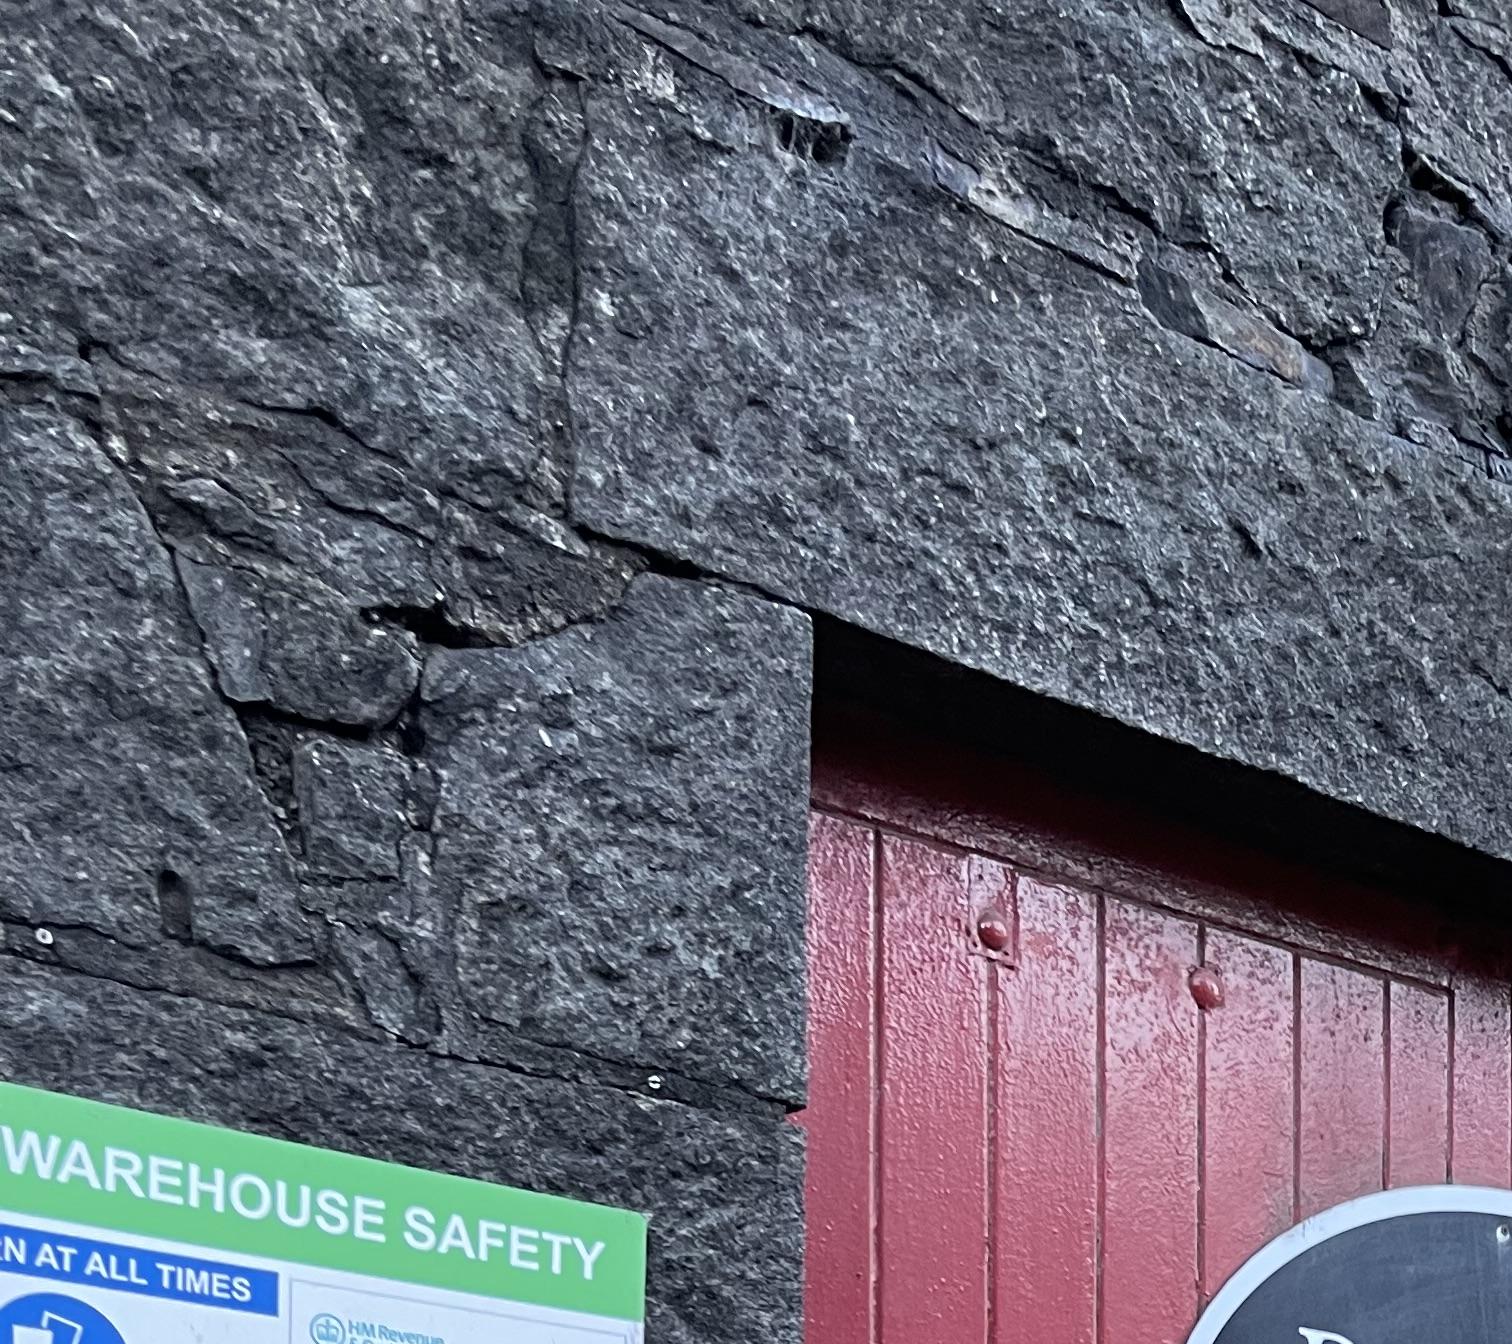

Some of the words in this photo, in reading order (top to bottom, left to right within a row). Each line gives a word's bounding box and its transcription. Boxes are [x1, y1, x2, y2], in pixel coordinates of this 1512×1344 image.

[0, 1124, 386, 1244] WAREHOUSE
[403, 1206, 605, 1280] SAFETY
[0, 1234, 26, 1264] N
[34, 1242, 78, 1272] AT
[84, 1251, 148, 1286] ALL
[155, 1263, 252, 1302] TIMES
[348, 1318, 377, 1339] HM
